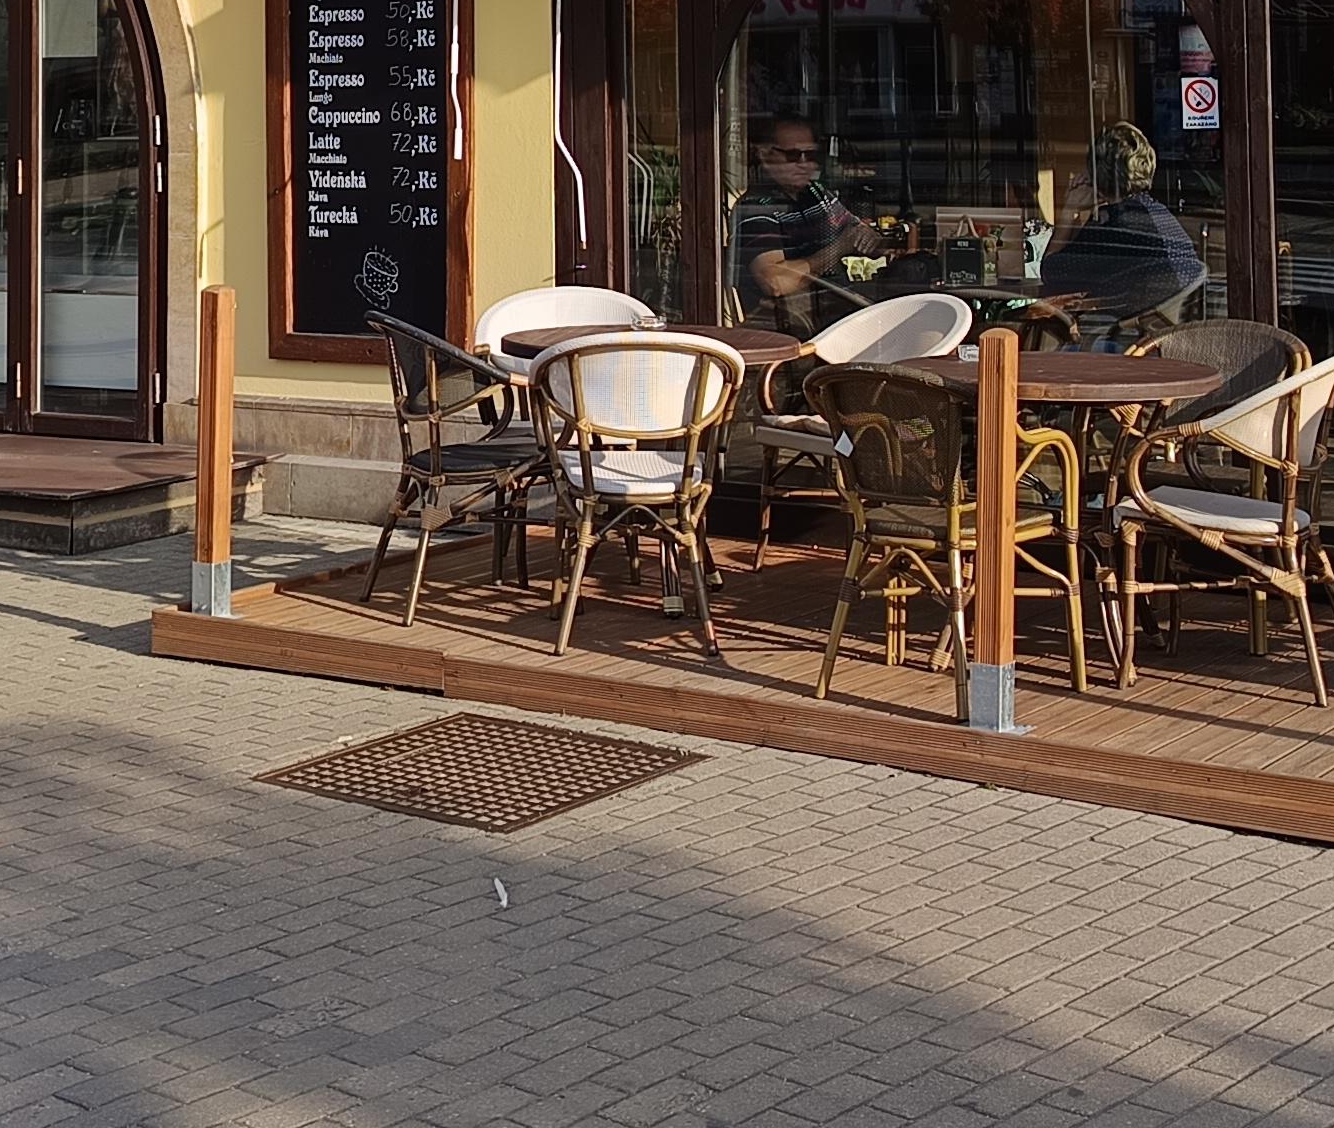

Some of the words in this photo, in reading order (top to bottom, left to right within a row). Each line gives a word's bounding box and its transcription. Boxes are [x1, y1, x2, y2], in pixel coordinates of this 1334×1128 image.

[308, 4, 365, 26] Espresso
[308, 30, 365, 52] Espresso
[308, 69, 365, 91] Espresso
[308, 105, 381, 128] Cappuccino
[308, 131, 341, 150] Latte
[308, 190, 328, 203] Káva
[308, 205, 359, 224] Turecká
[308, 225, 329, 238] Káva
